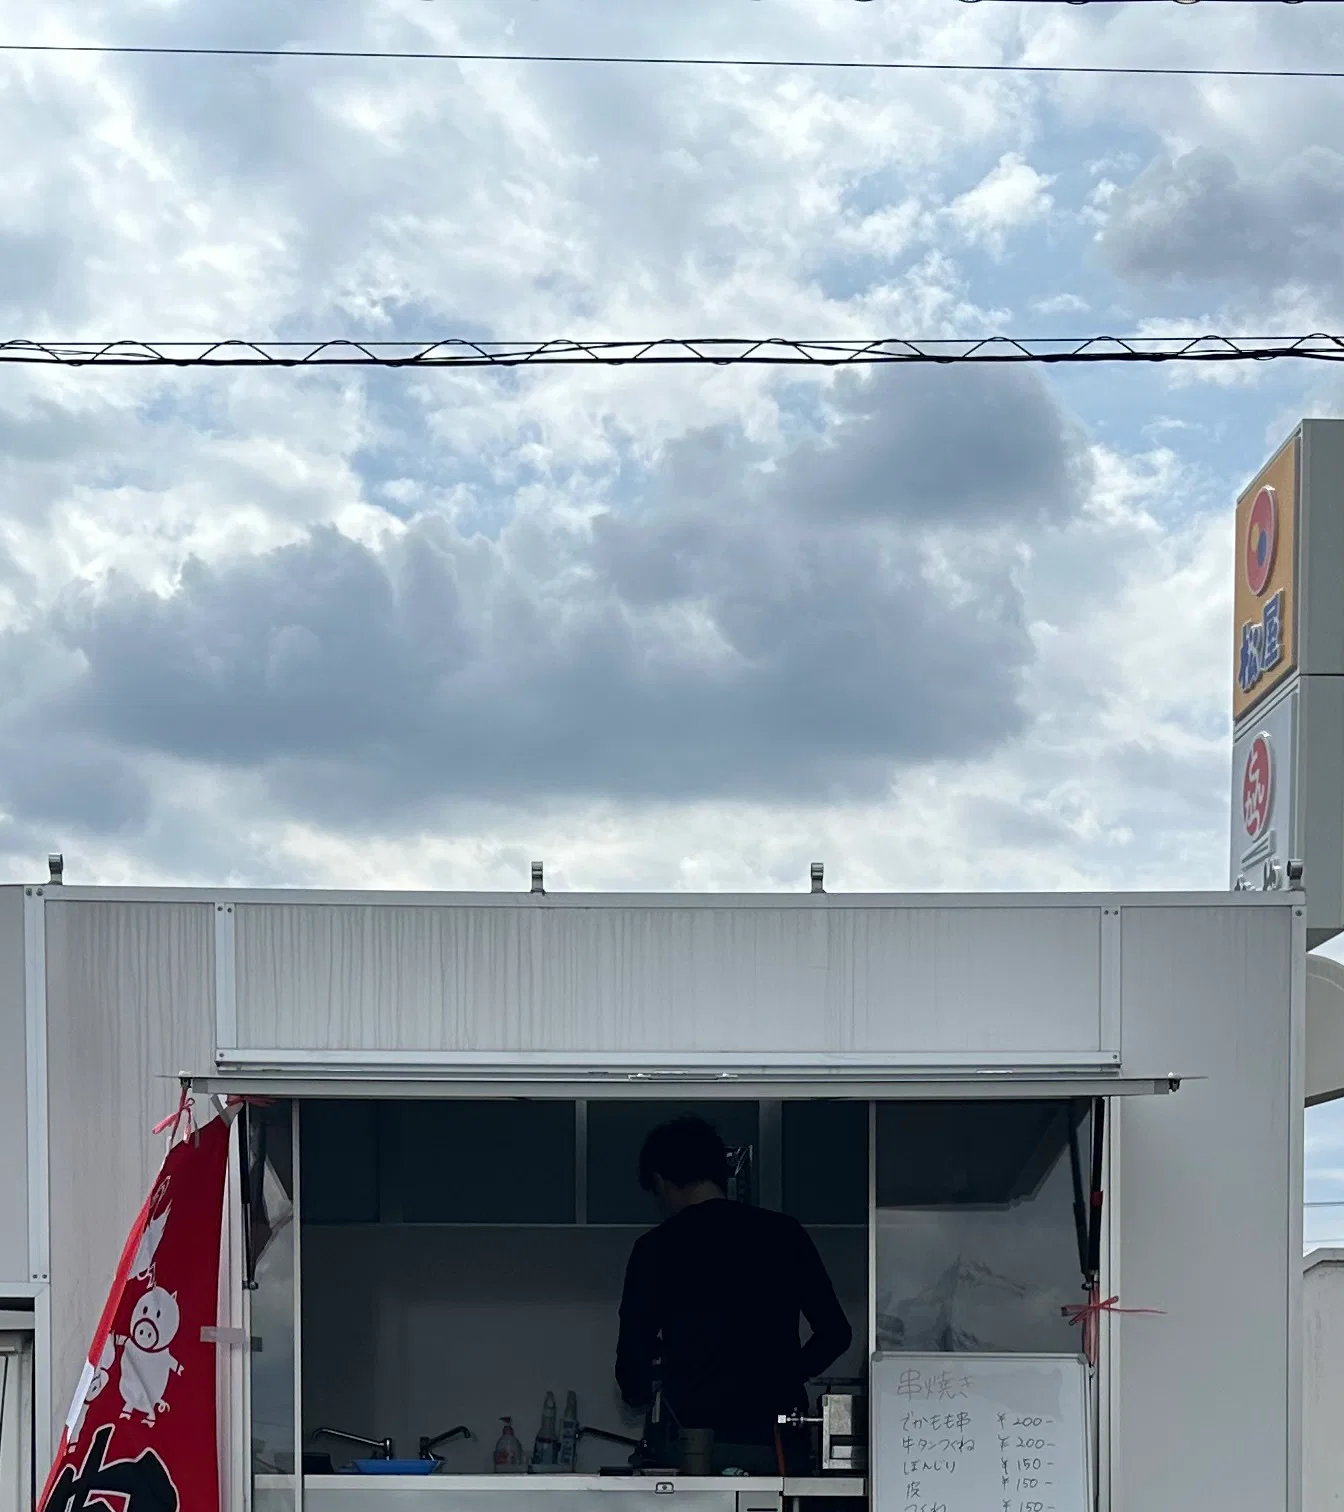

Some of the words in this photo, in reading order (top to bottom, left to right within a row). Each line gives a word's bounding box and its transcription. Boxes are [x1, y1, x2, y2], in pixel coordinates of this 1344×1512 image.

[1237, 590, 1282, 692] 松屋
[897, 1368, 973, 1400] 串焼き
[900, 1410, 971, 1432] でかもも串
[902, 1436, 975, 1453] 牛タンつくね
[903, 1459, 956, 1476] ぼんじり
[906, 1480, 921, 1499] 皮
